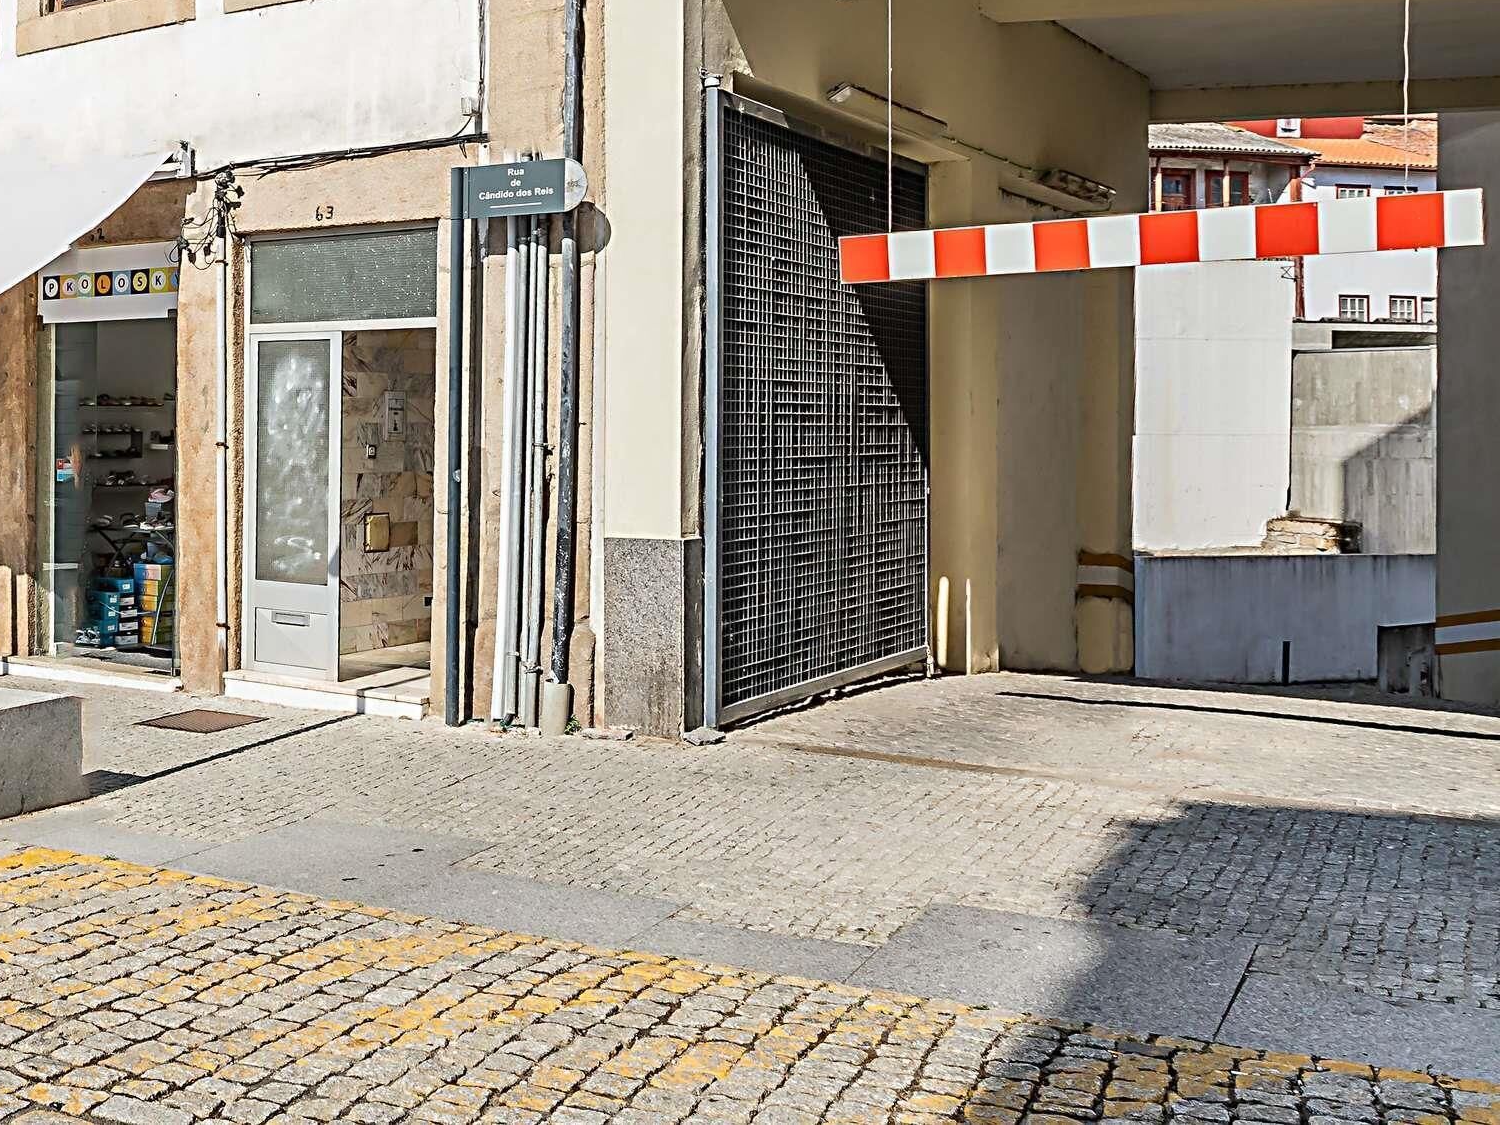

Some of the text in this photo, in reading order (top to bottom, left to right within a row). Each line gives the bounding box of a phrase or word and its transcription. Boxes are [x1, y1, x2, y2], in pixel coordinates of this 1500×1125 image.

[507, 168, 525, 176] Rua
[510, 178, 522, 187] de
[478, 186, 554, 201] Cândido dos Reis
[315, 205, 334, 222] 63
